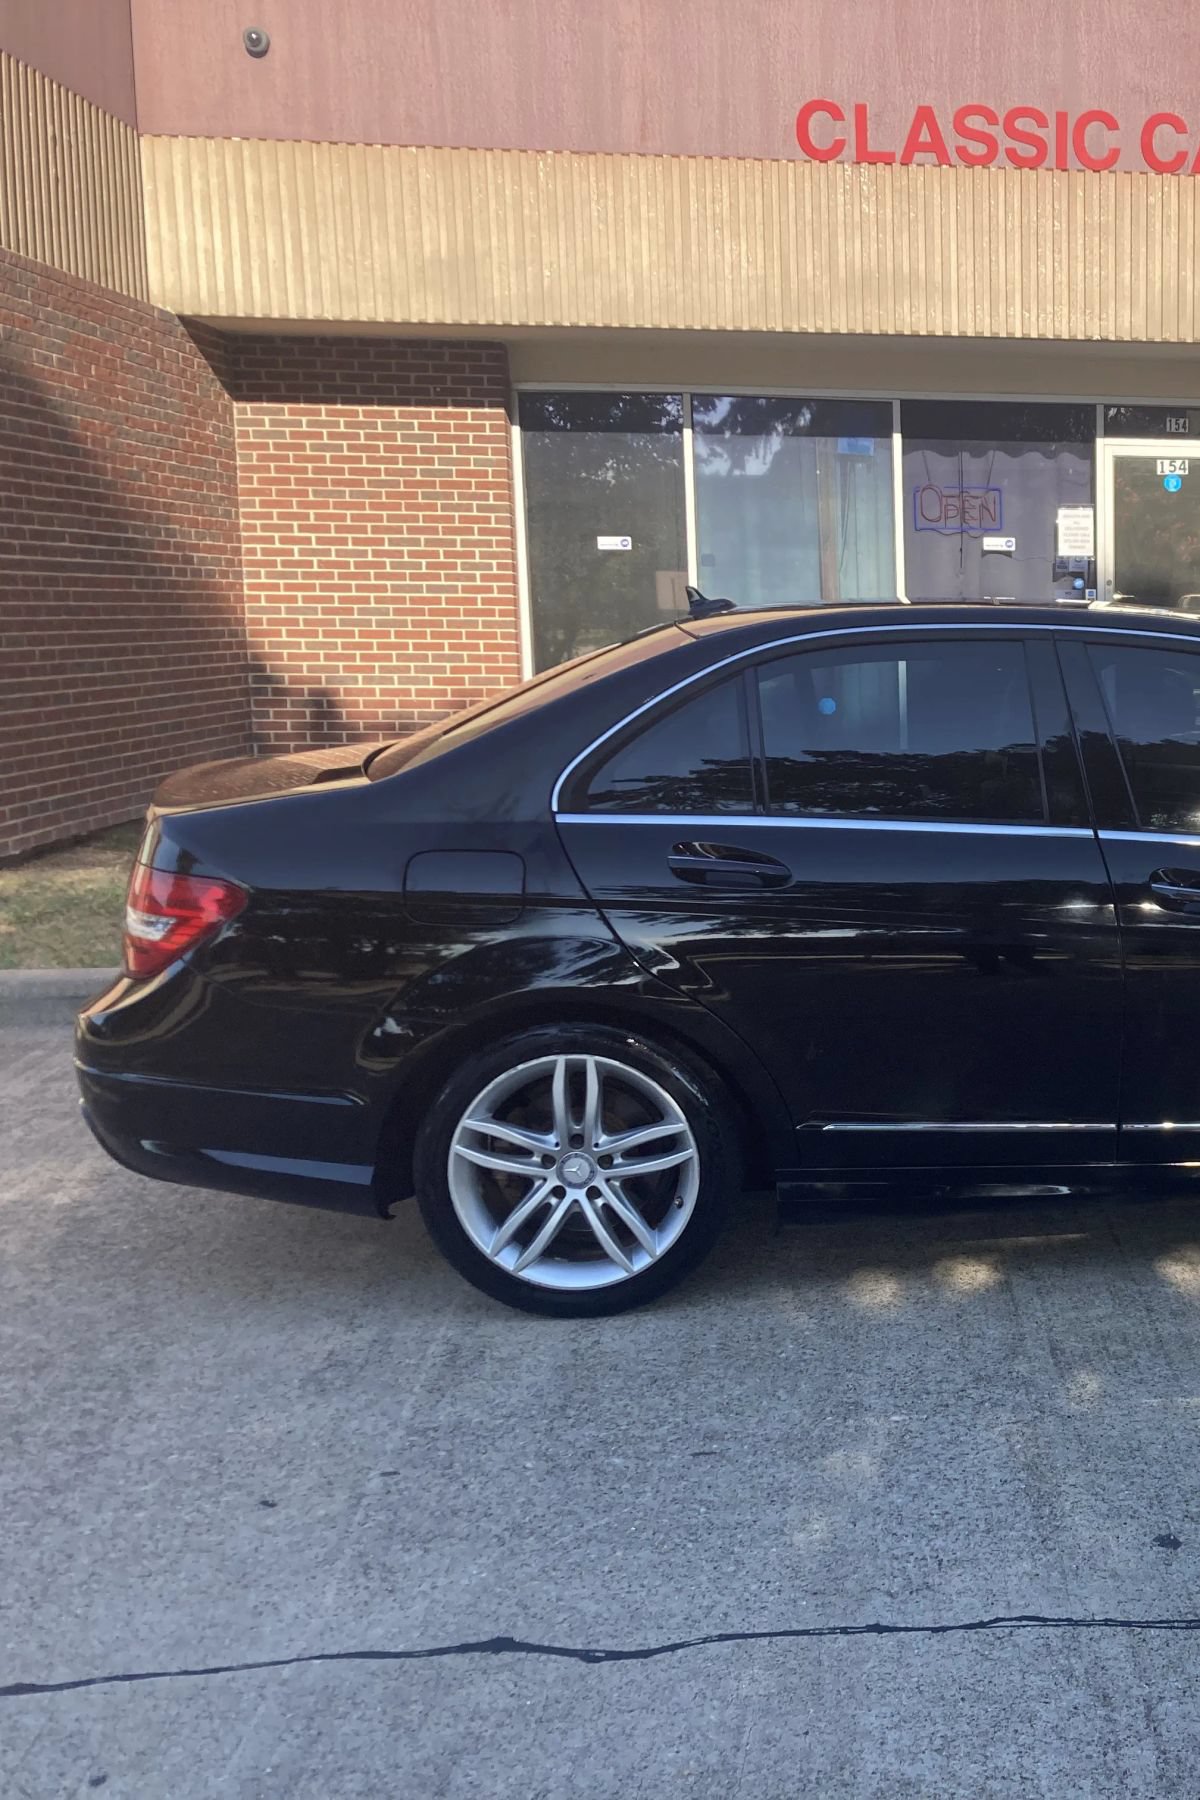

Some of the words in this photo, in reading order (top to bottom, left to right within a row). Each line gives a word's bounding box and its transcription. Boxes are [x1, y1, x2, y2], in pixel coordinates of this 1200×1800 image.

[795, 98, 1121, 172] CLASSIC
[1168, 418, 1187, 432] 154
[1159, 460, 1187, 474] 154
